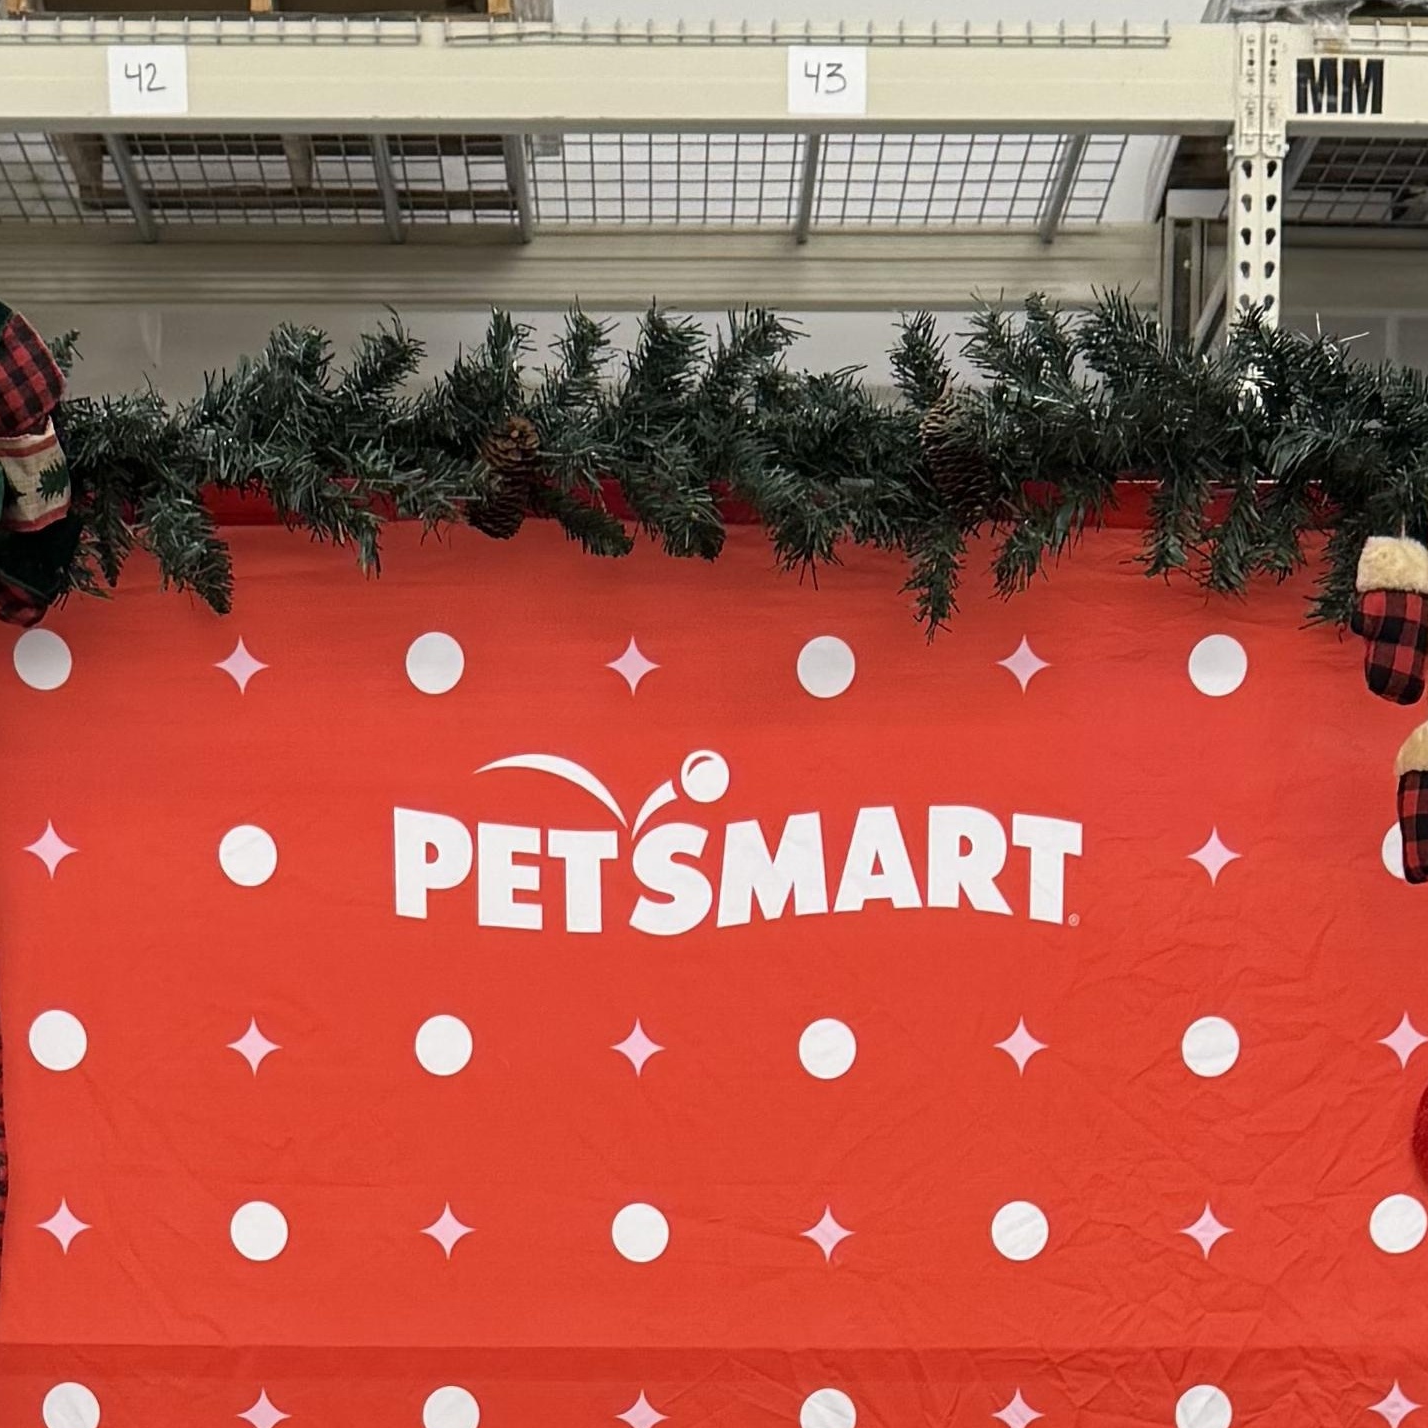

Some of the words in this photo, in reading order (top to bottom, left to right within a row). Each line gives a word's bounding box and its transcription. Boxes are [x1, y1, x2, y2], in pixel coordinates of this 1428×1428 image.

[123, 61, 167, 94] 42
[802, 60, 846, 96] 43
[1295, 57, 1384, 115] MM
[392, 804, 1083, 936] PETSMART
